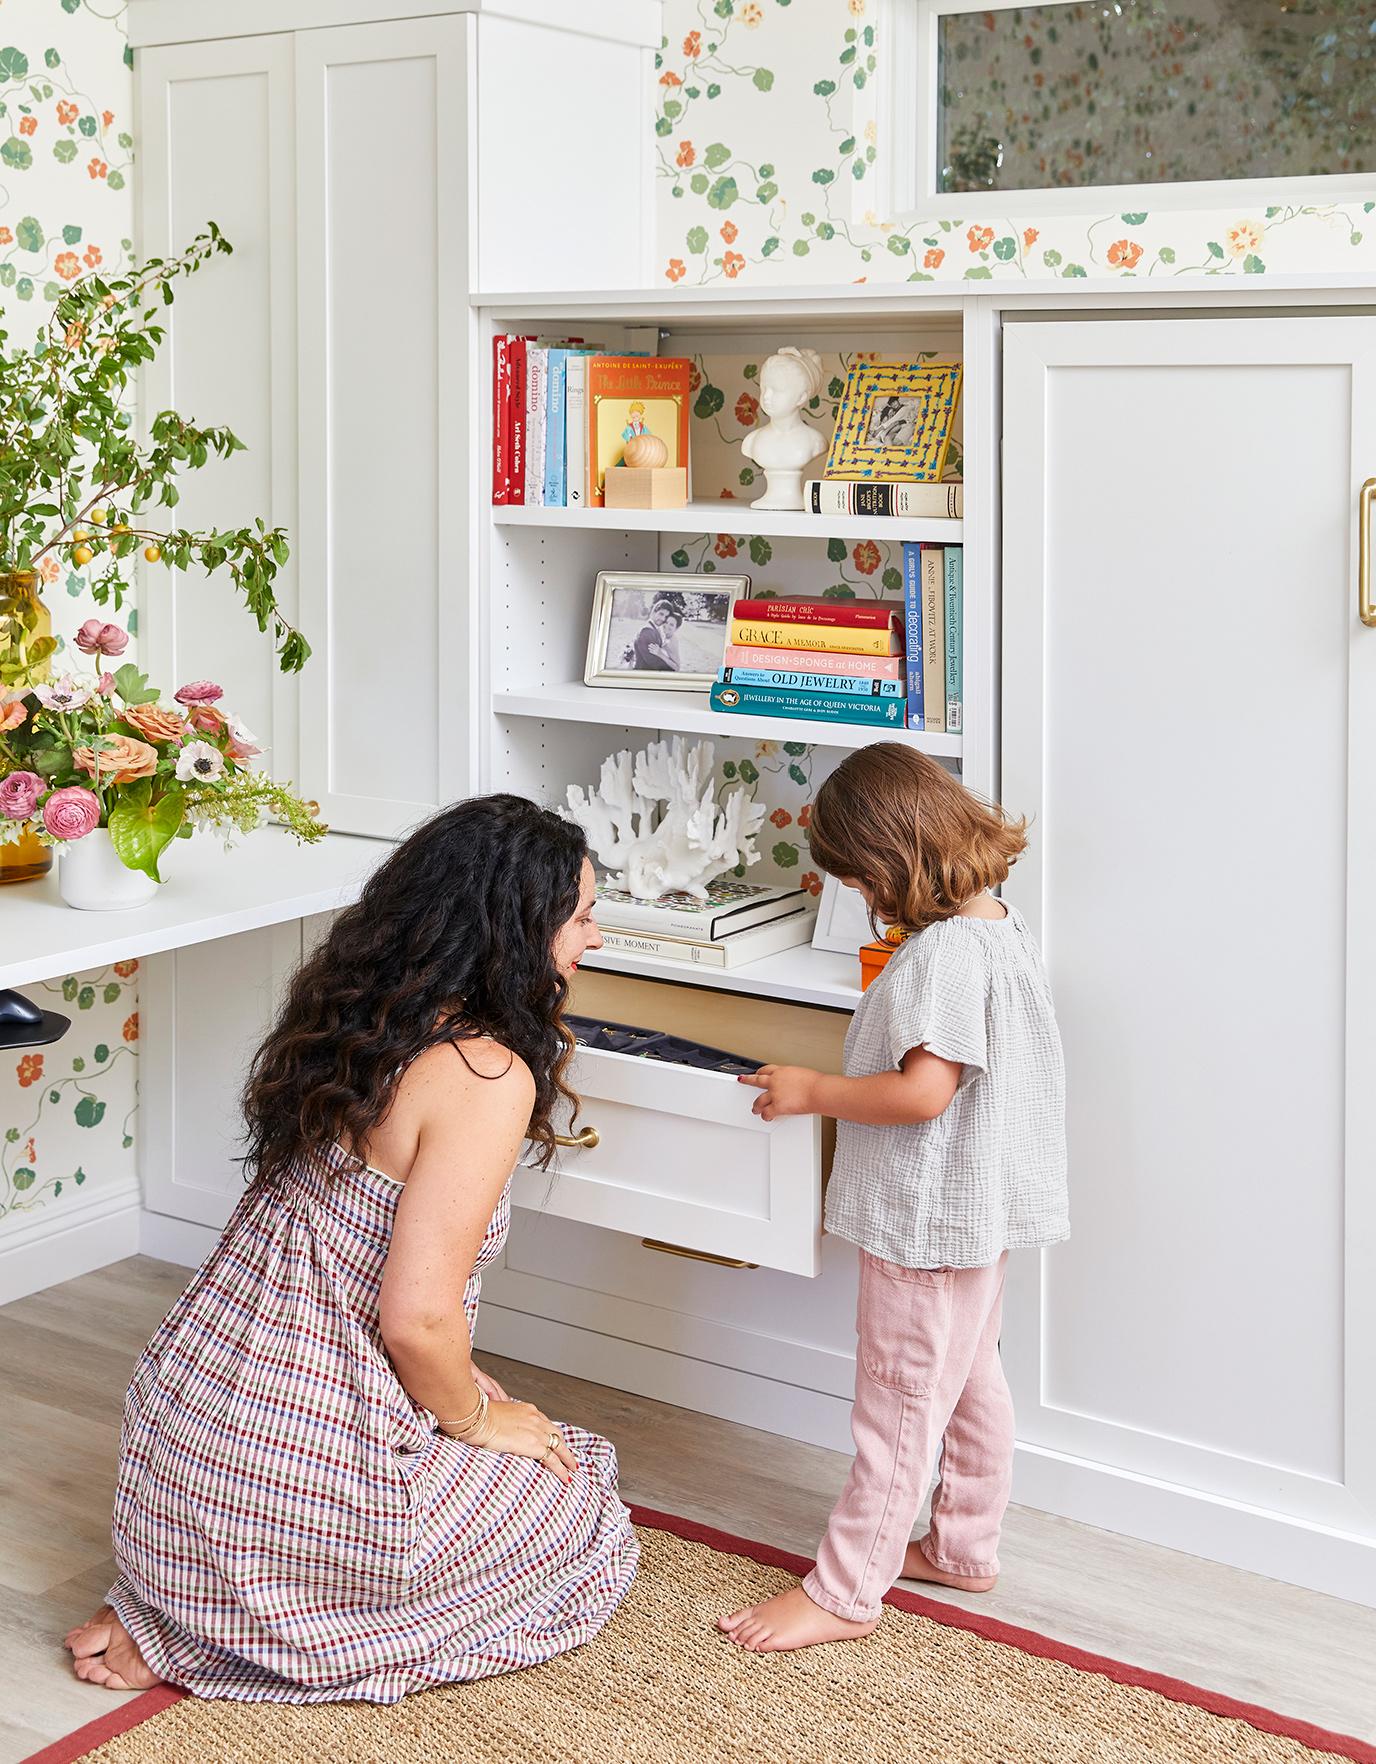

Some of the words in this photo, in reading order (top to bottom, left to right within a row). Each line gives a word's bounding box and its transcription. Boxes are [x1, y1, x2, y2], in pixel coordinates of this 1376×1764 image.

[531, 366, 541, 412] domino
[551, 366, 561, 413] domino
[597, 374, 614, 389] The
[615, 374, 641, 391] Little
[646, 374, 682, 391] Prince
[908, 558, 916, 578] GIRL'S
[948, 557, 957, 584] Antique
[767, 604, 796, 613] PARISIAN
[799, 606, 814, 614] CHIC
[910, 601, 916, 609] TO
[949, 592, 957, 625] Twentieth
[739, 627, 784, 645] GRACE
[792, 638, 827, 648] MEMOIR
[907, 610, 922, 662] decorating
[928, 628, 936, 638] AT
[948, 626, 957, 655] Century
[928, 639, 937, 665] WORK
[836, 661, 847, 669] at
[848, 659, 877, 672] HOME
[948, 655, 957, 686] Jewellery
[772, 673, 798, 685] OLD
[800, 675, 857, 690] JEWELRY
[743, 694, 776, 703] JEWELLERY
[800, 698, 812, 706] AGE
[823, 700, 846, 709] QUEEN
[847, 702, 881, 712] VICTORIA
[602, 935, 621, 946] SIVE
[624, 939, 661, 952] MOMENT
